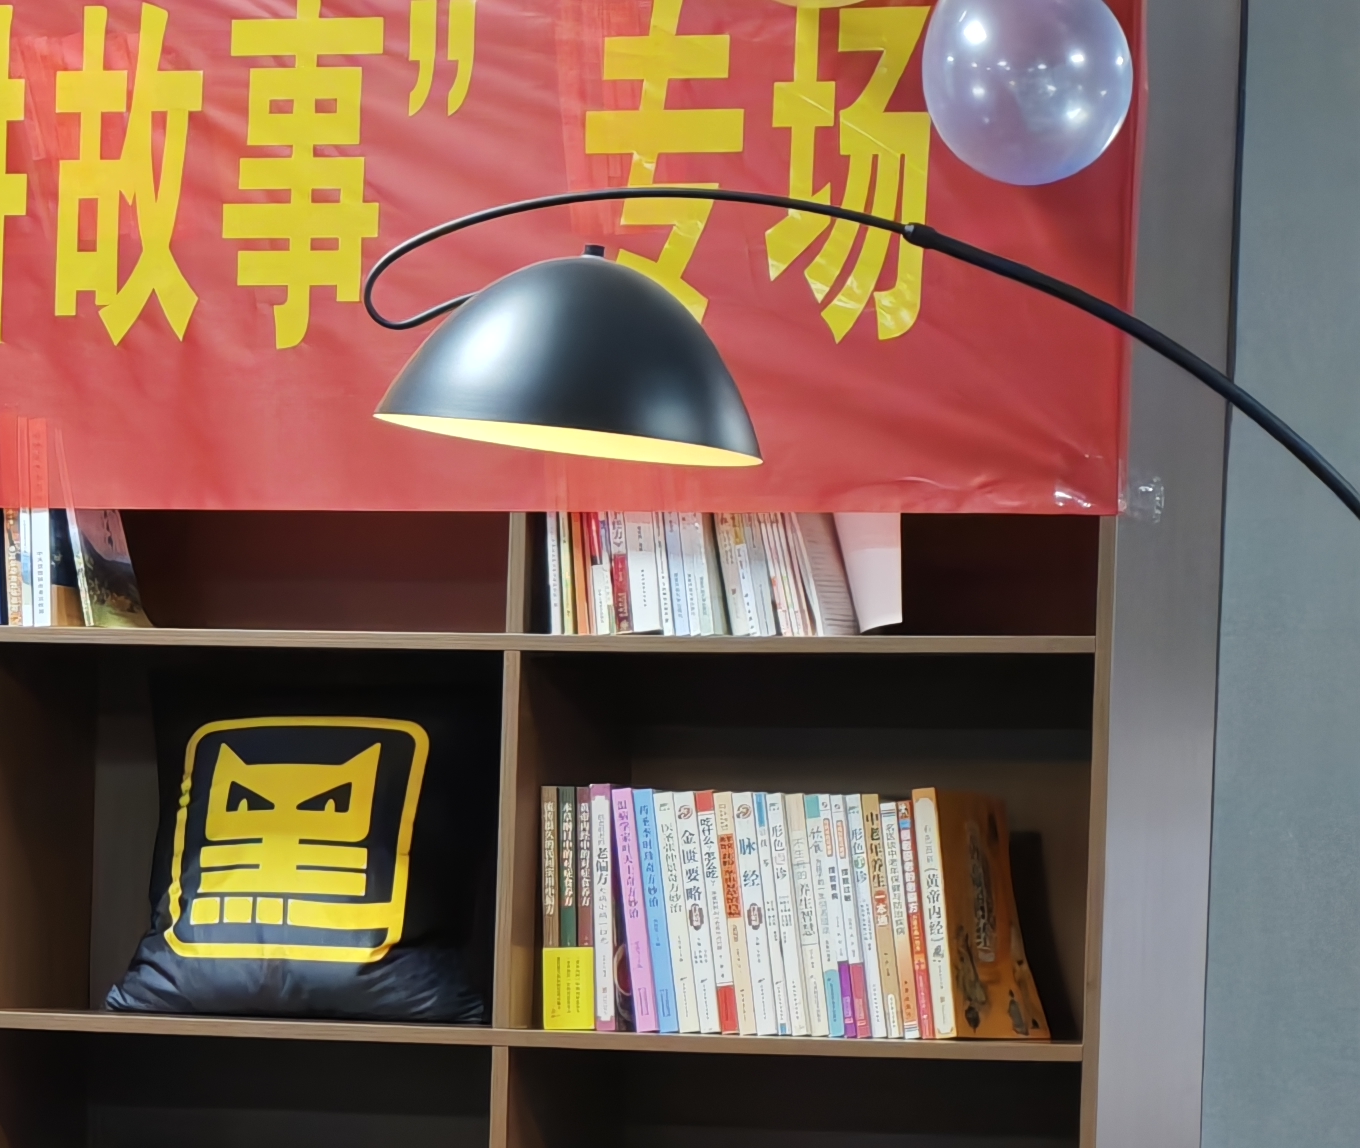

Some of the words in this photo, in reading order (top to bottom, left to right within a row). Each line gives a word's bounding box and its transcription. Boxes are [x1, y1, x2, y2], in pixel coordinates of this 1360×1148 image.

[585, 0, 933, 342] 专场
[595, 847, 609, 886] 老偏方
[680, 830, 703, 902] 金匮要略
[739, 837, 760, 887] 脉经
